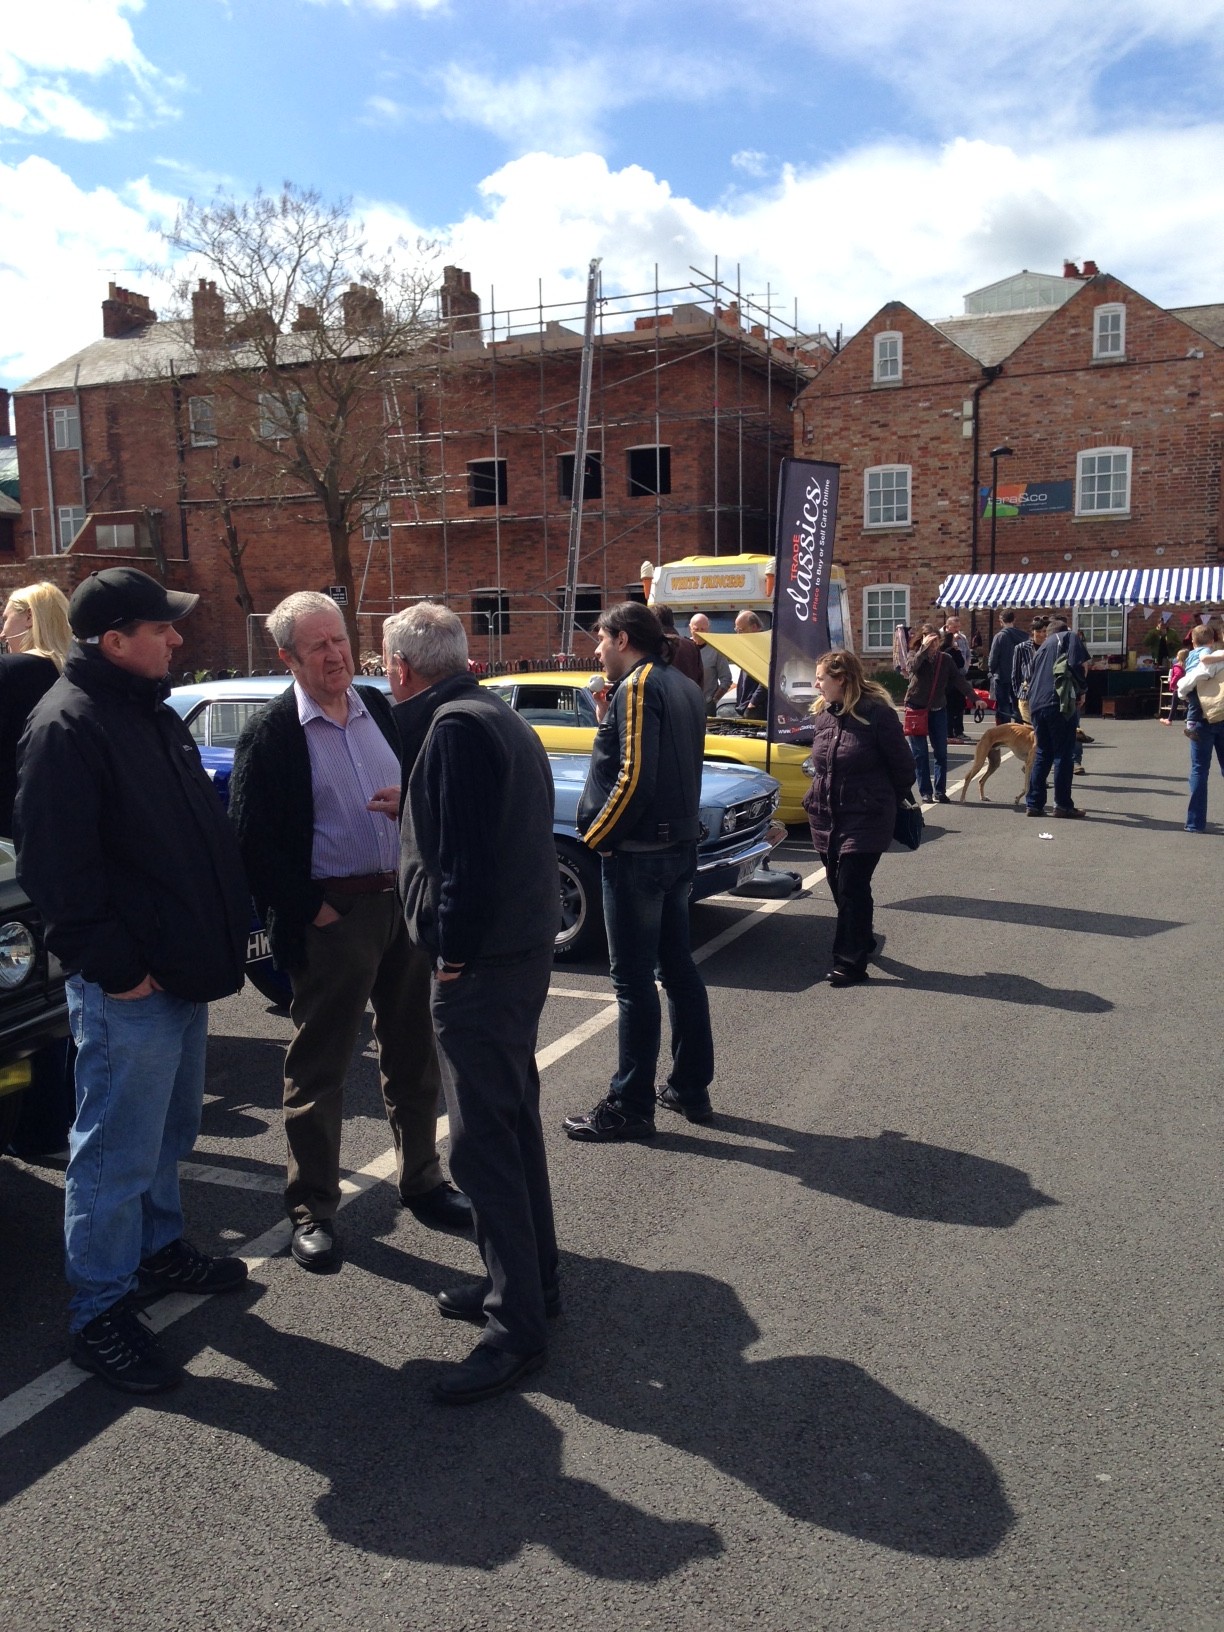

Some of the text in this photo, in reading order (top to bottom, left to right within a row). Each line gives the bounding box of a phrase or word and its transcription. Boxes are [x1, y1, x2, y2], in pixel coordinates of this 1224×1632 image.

[822, 479, 831, 507] Online
[820, 509, 828, 528] Cars
[786, 476, 821, 622] classics
[790, 534, 801, 581] TRADE
[819, 548, 825, 557] or
[816, 559, 824, 576] Buy
[815, 577, 821, 586] to
